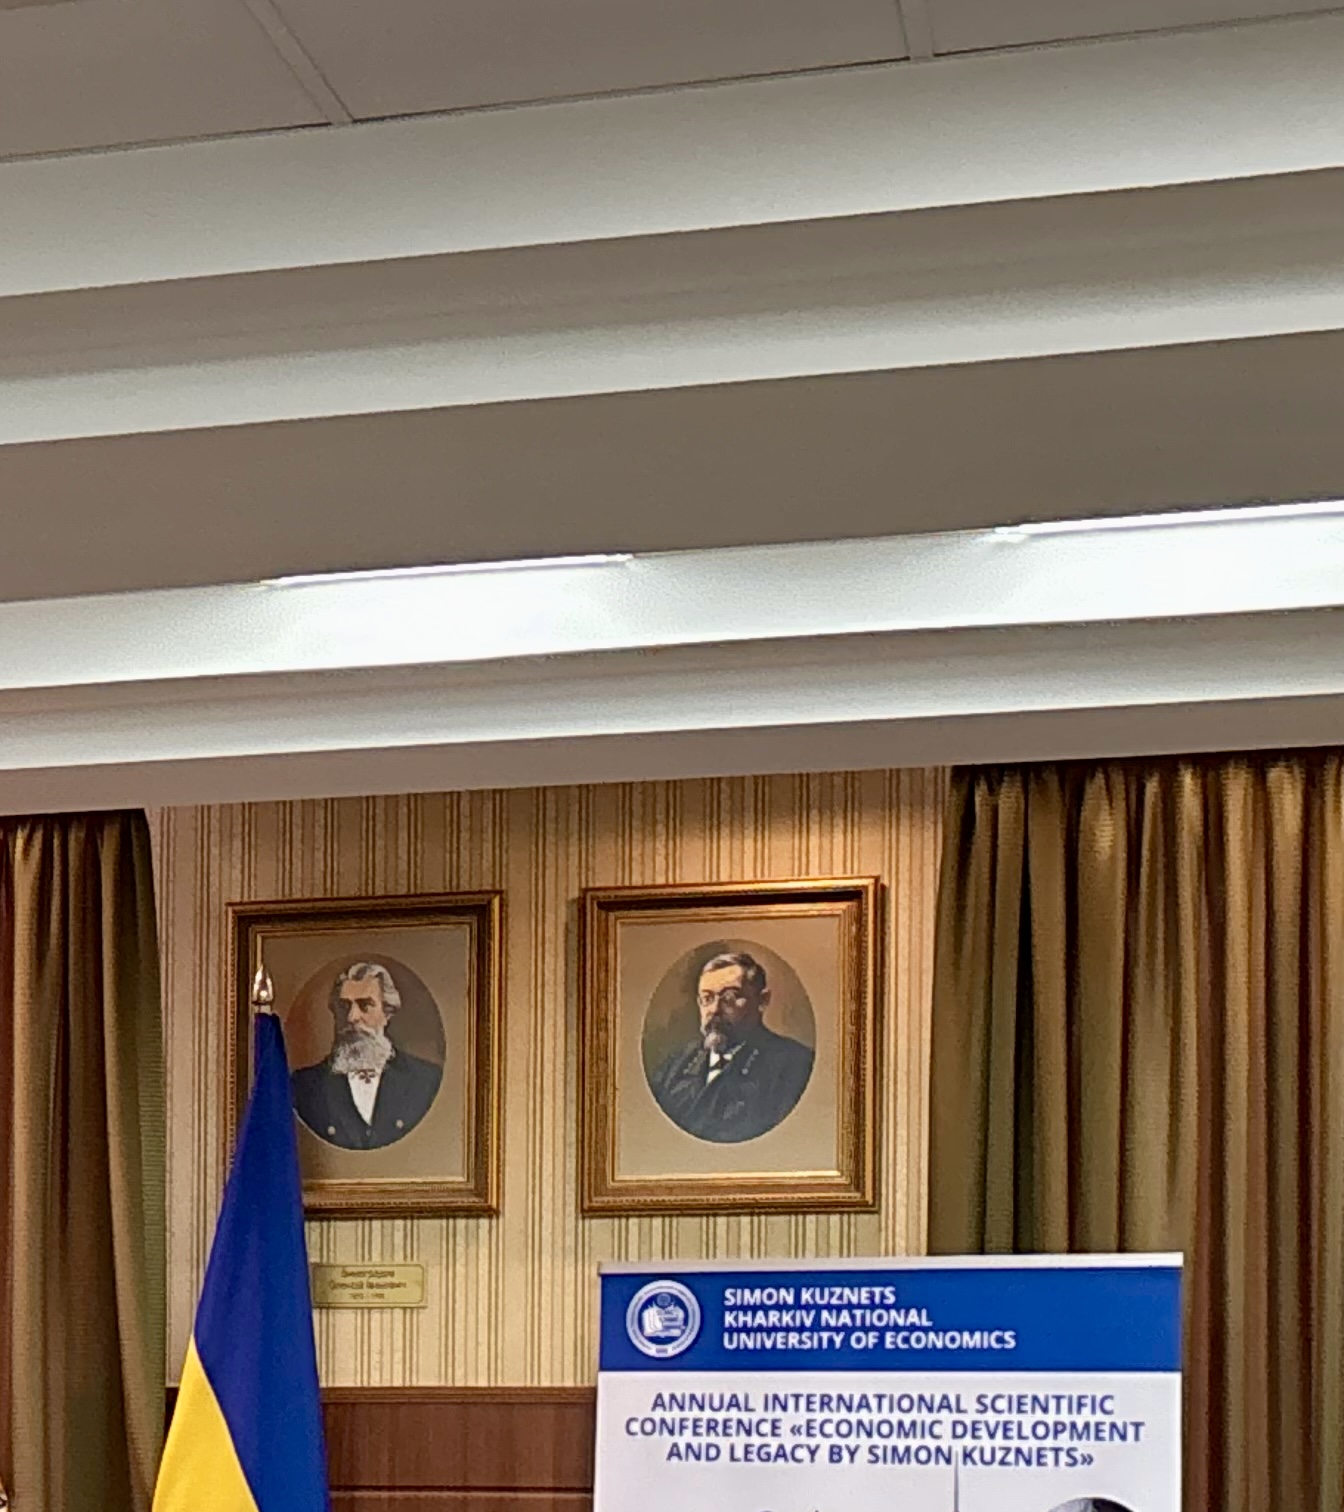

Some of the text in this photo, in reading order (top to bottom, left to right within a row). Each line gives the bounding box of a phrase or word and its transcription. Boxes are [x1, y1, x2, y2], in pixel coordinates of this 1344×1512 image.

[724, 1287, 896, 1306] SIMON KUZNETS
[724, 1309, 933, 1328] KHARKIV NATIONAL
[723, 1331, 1016, 1350] UNIVERSITY OF ECONOMICS
[651, 1393, 1114, 1415] ANNUAL INTERNATIONAL SCIENTIFIC
[625, 1416, 1145, 1442] CONFERENCE «ECONOMIC DEVELOPMENT
[666, 1442, 1094, 1467] AND LEGACY BY SIMON KUZNETS»
